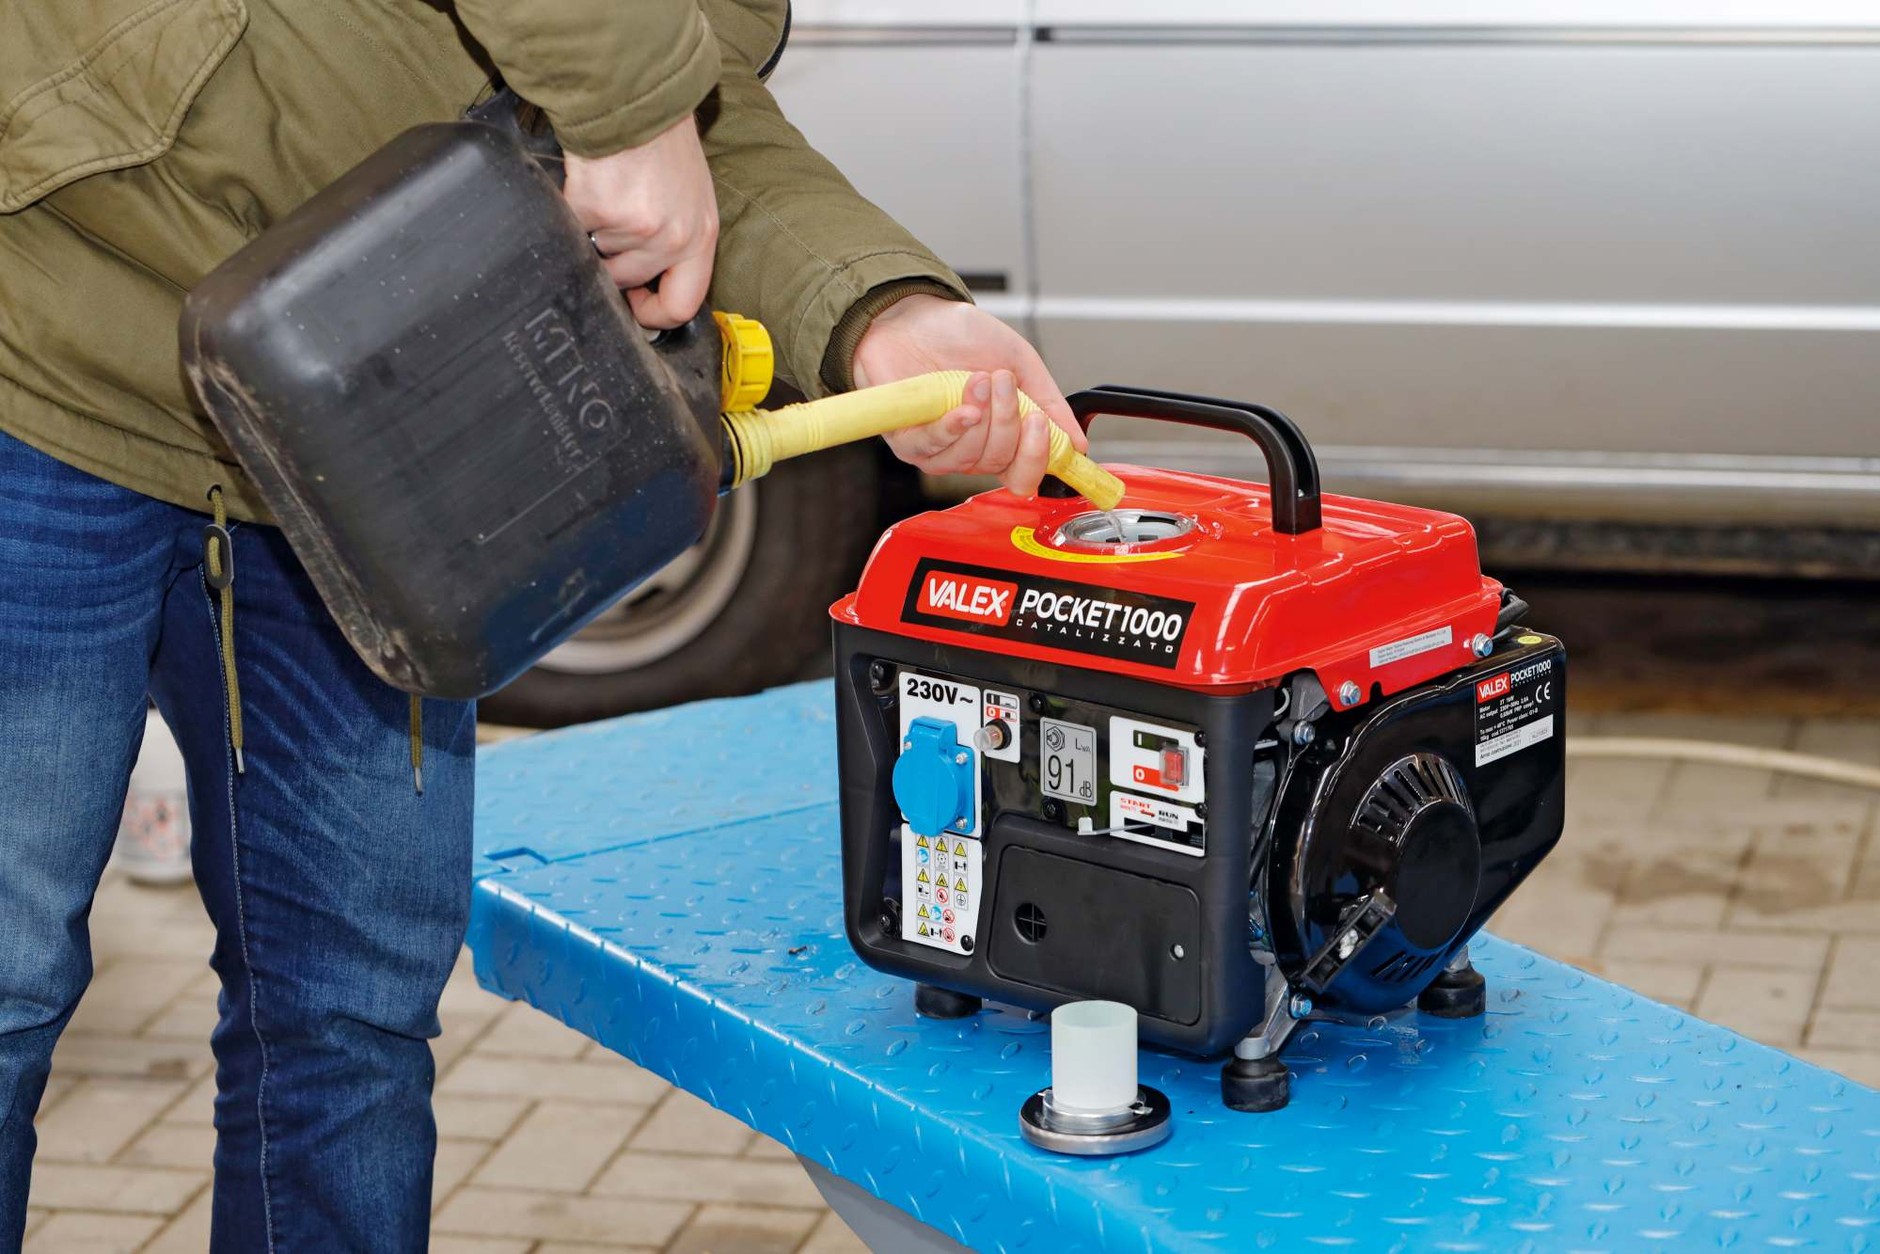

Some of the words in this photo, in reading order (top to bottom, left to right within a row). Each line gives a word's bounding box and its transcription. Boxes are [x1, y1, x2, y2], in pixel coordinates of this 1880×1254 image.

[928, 578, 1010, 618] VALEX
[1019, 588, 1183, 641] POCKET1000
[1016, 618, 1174, 653] CATALIZZATO
[1479, 676, 1508, 699] VALEX
[1511, 659, 1551, 684] POCKET1000
[1048, 754, 1074, 793] 91
[1079, 780, 1092, 798] dB
[1120, 798, 1151, 808] START
[1159, 810, 1178, 820] RUN
